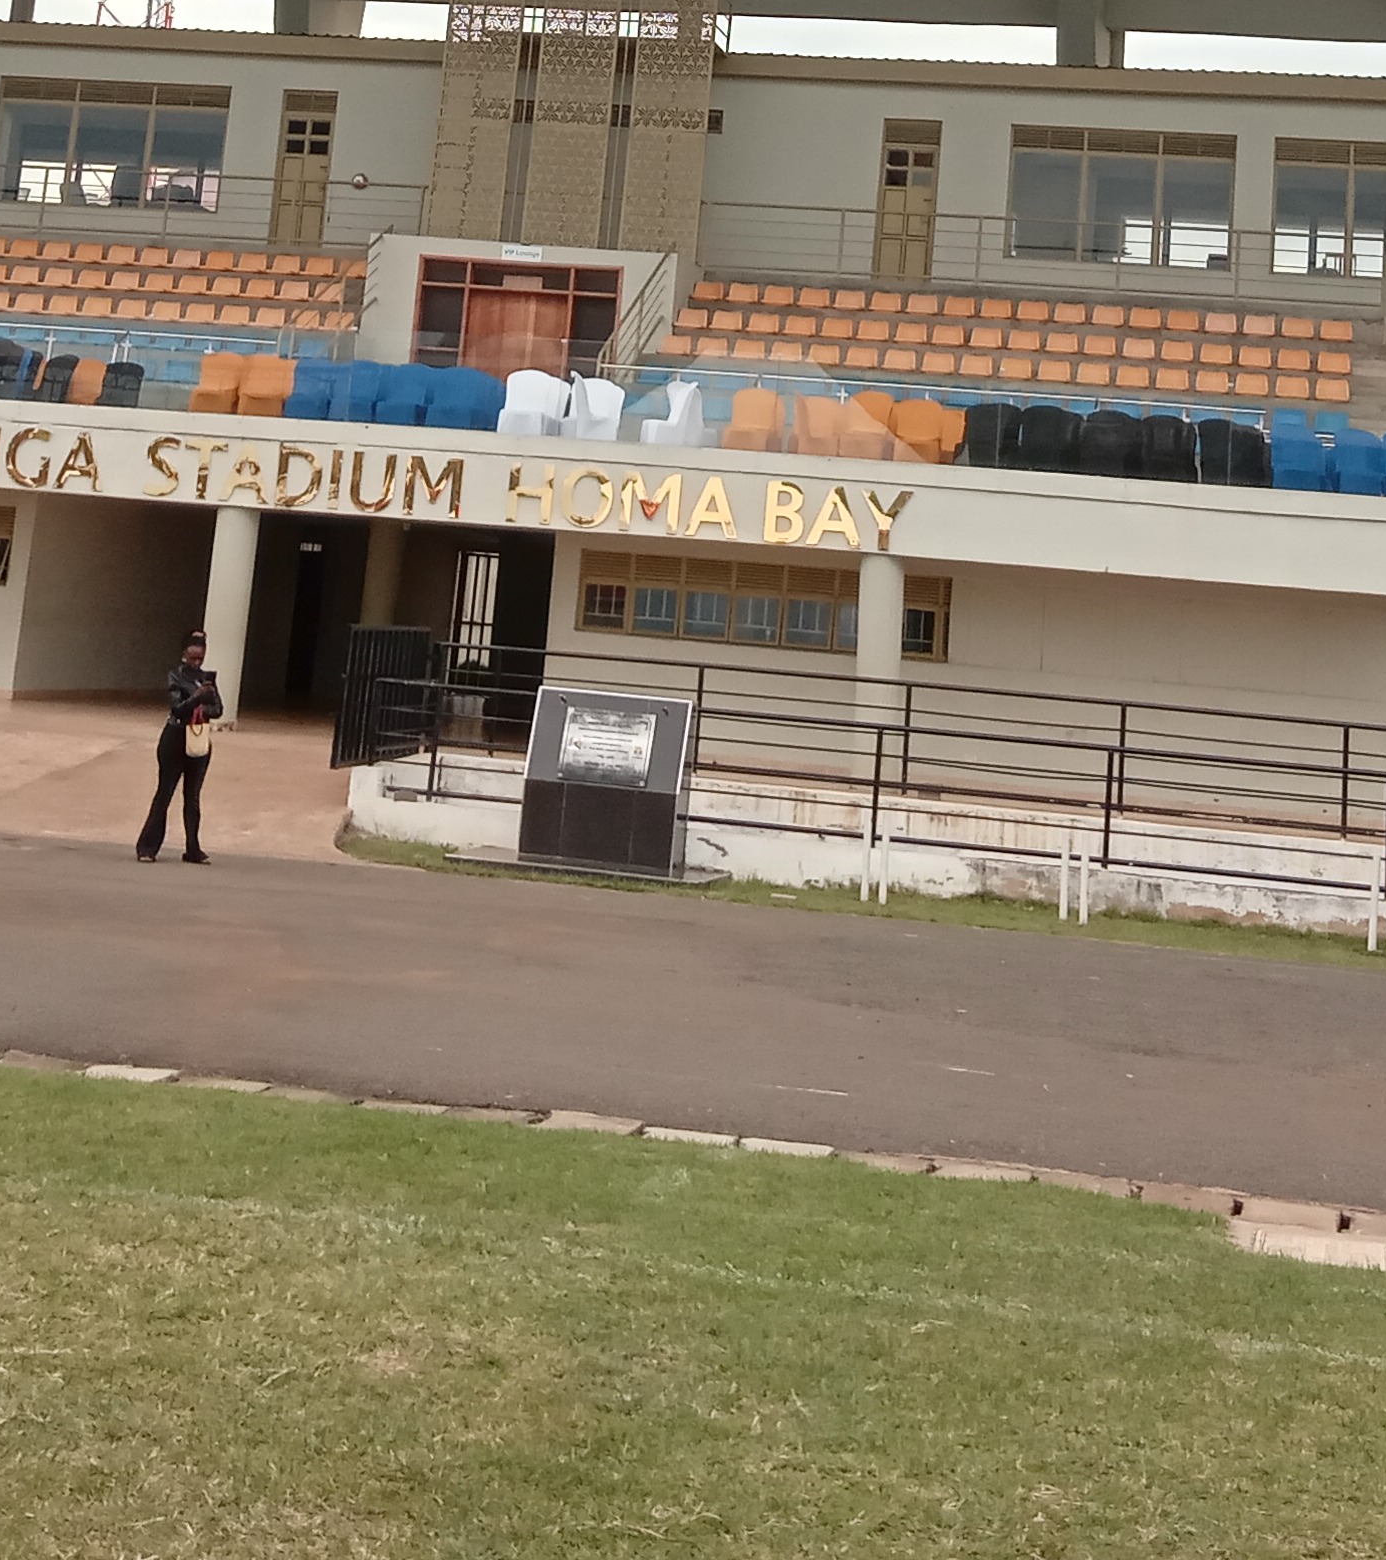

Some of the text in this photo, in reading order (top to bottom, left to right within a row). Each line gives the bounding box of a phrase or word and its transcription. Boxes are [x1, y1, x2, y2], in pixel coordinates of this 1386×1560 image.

[143, 436, 463, 518] STADIUM
[507, 462, 737, 540] HOMA
[765, 480, 913, 550] BAY
